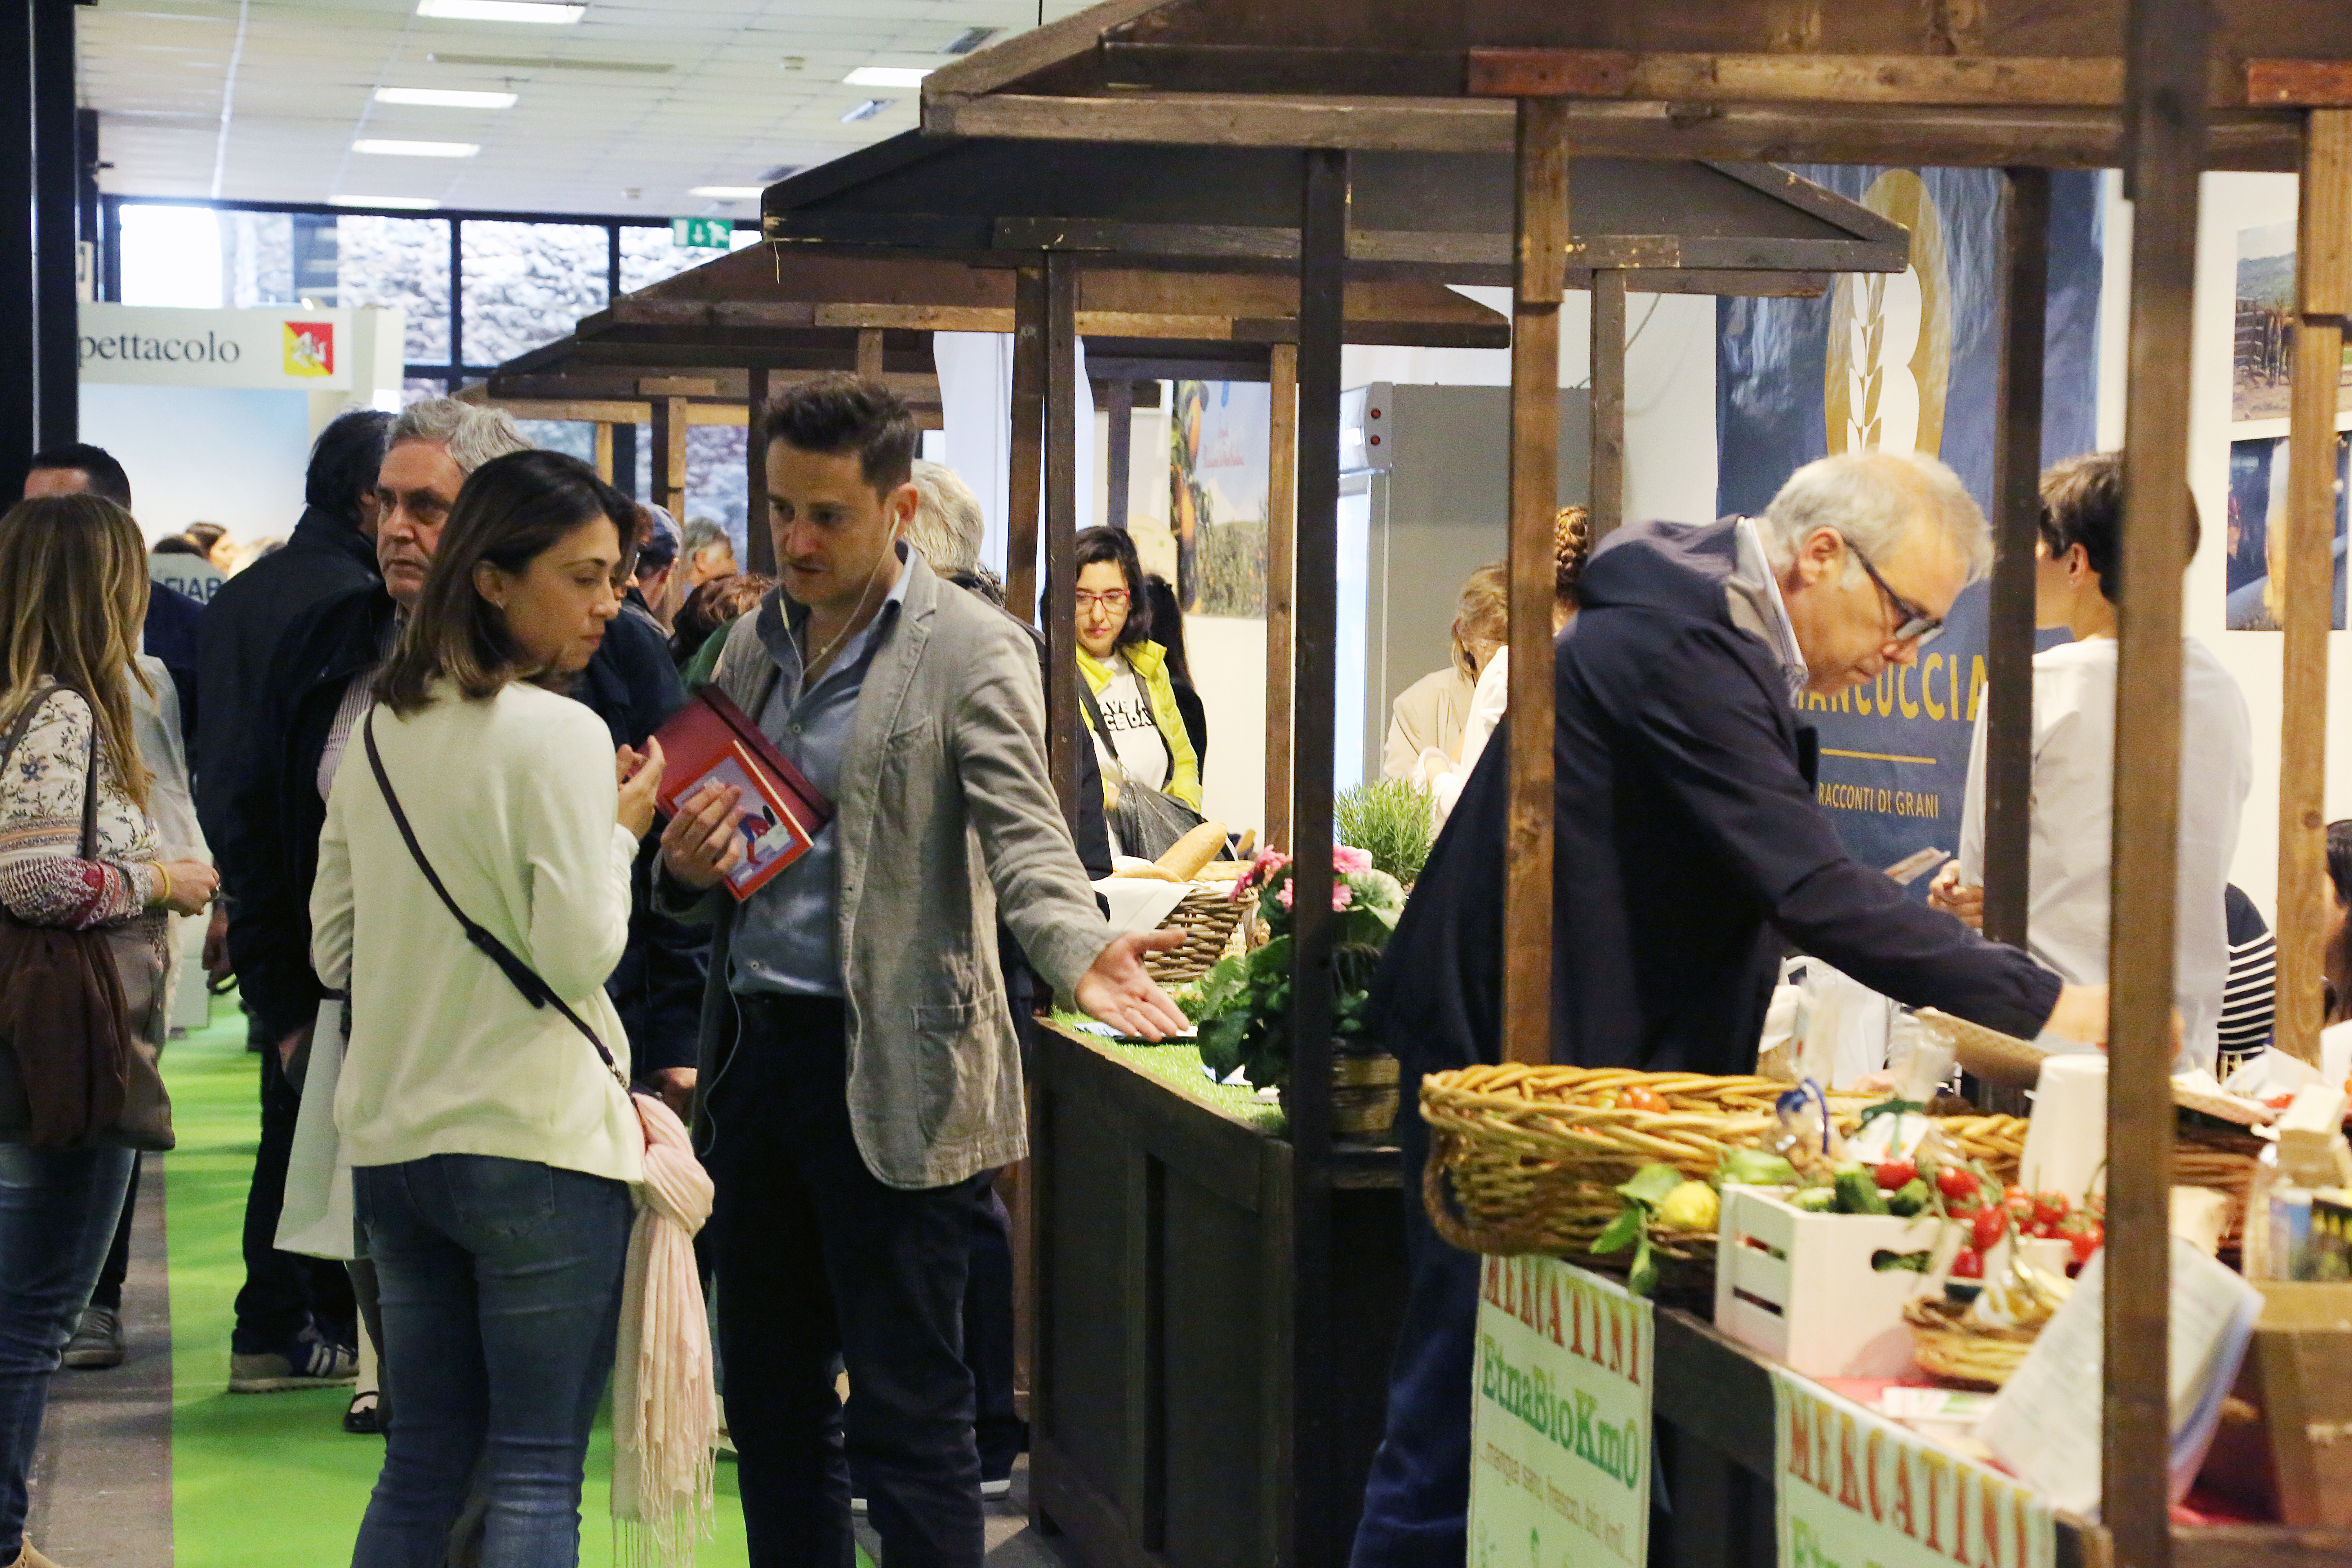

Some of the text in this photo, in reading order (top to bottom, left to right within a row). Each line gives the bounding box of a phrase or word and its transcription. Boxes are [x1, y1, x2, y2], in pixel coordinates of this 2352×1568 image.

[1818, 782, 1939, 819] RACCONTI DI GRANI
